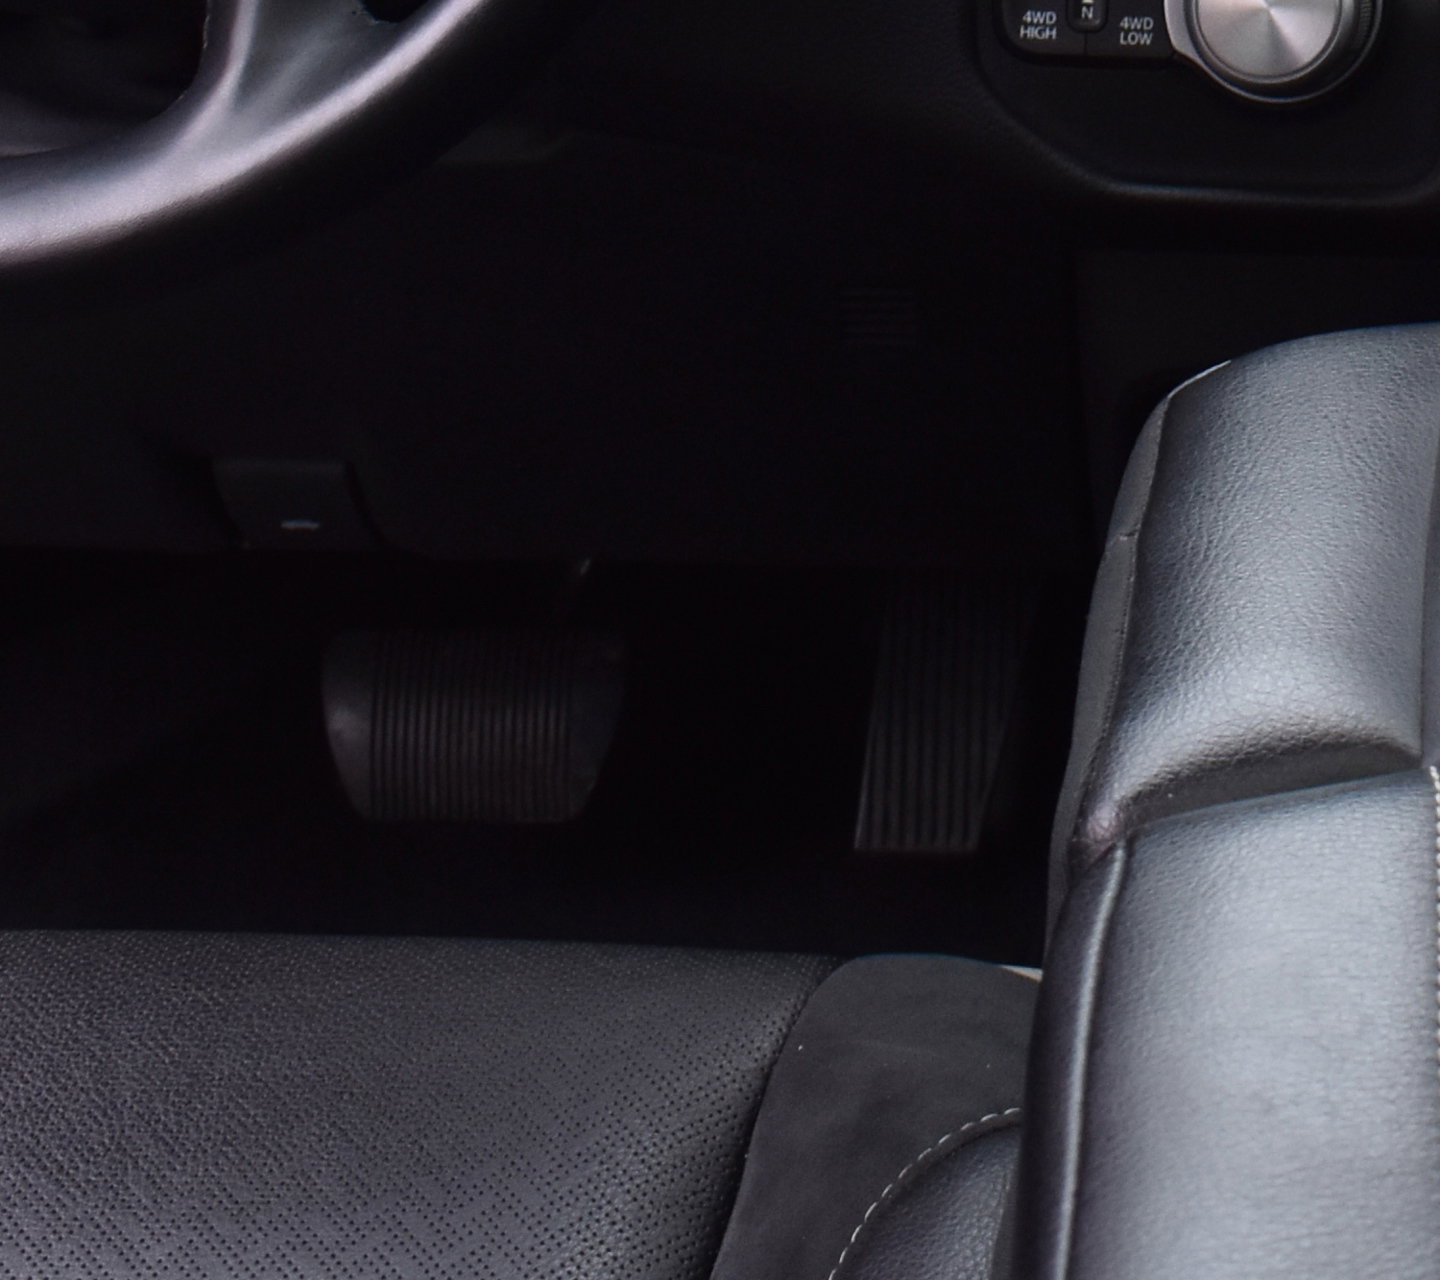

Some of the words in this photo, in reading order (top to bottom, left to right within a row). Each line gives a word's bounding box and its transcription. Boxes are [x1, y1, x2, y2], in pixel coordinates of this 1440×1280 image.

[1022, 11, 1057, 26] 4WD
[1081, 6, 1094, 20] N
[1120, 17, 1154, 31] 4WD
[1020, 25, 1057, 40] HIGH
[1120, 31, 1152, 45] LOW
